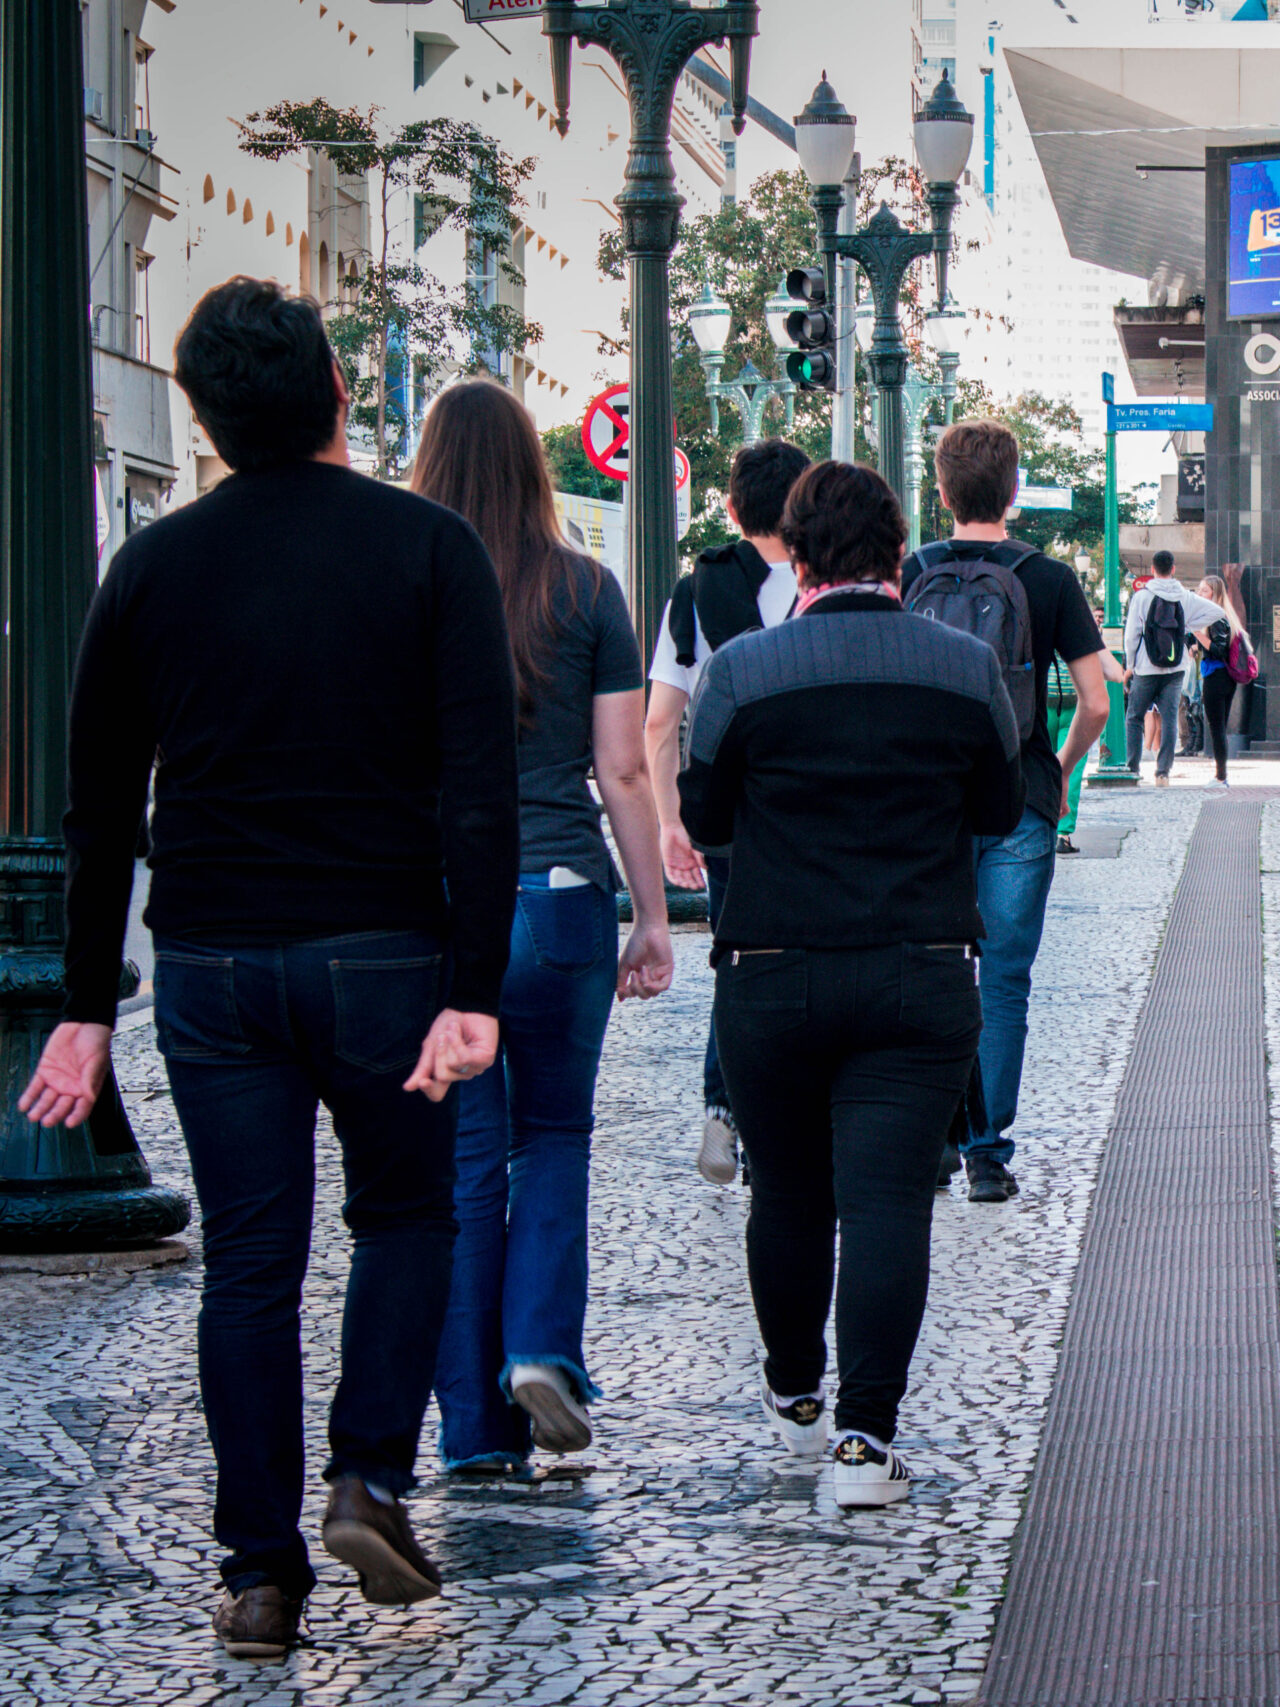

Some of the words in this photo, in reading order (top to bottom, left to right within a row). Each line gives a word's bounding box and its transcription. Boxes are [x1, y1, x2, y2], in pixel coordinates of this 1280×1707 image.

[1115, 408, 1127, 417] Tv.
[1129, 408, 1151, 417] Pres.
[1153, 407, 1176, 416] Faria
